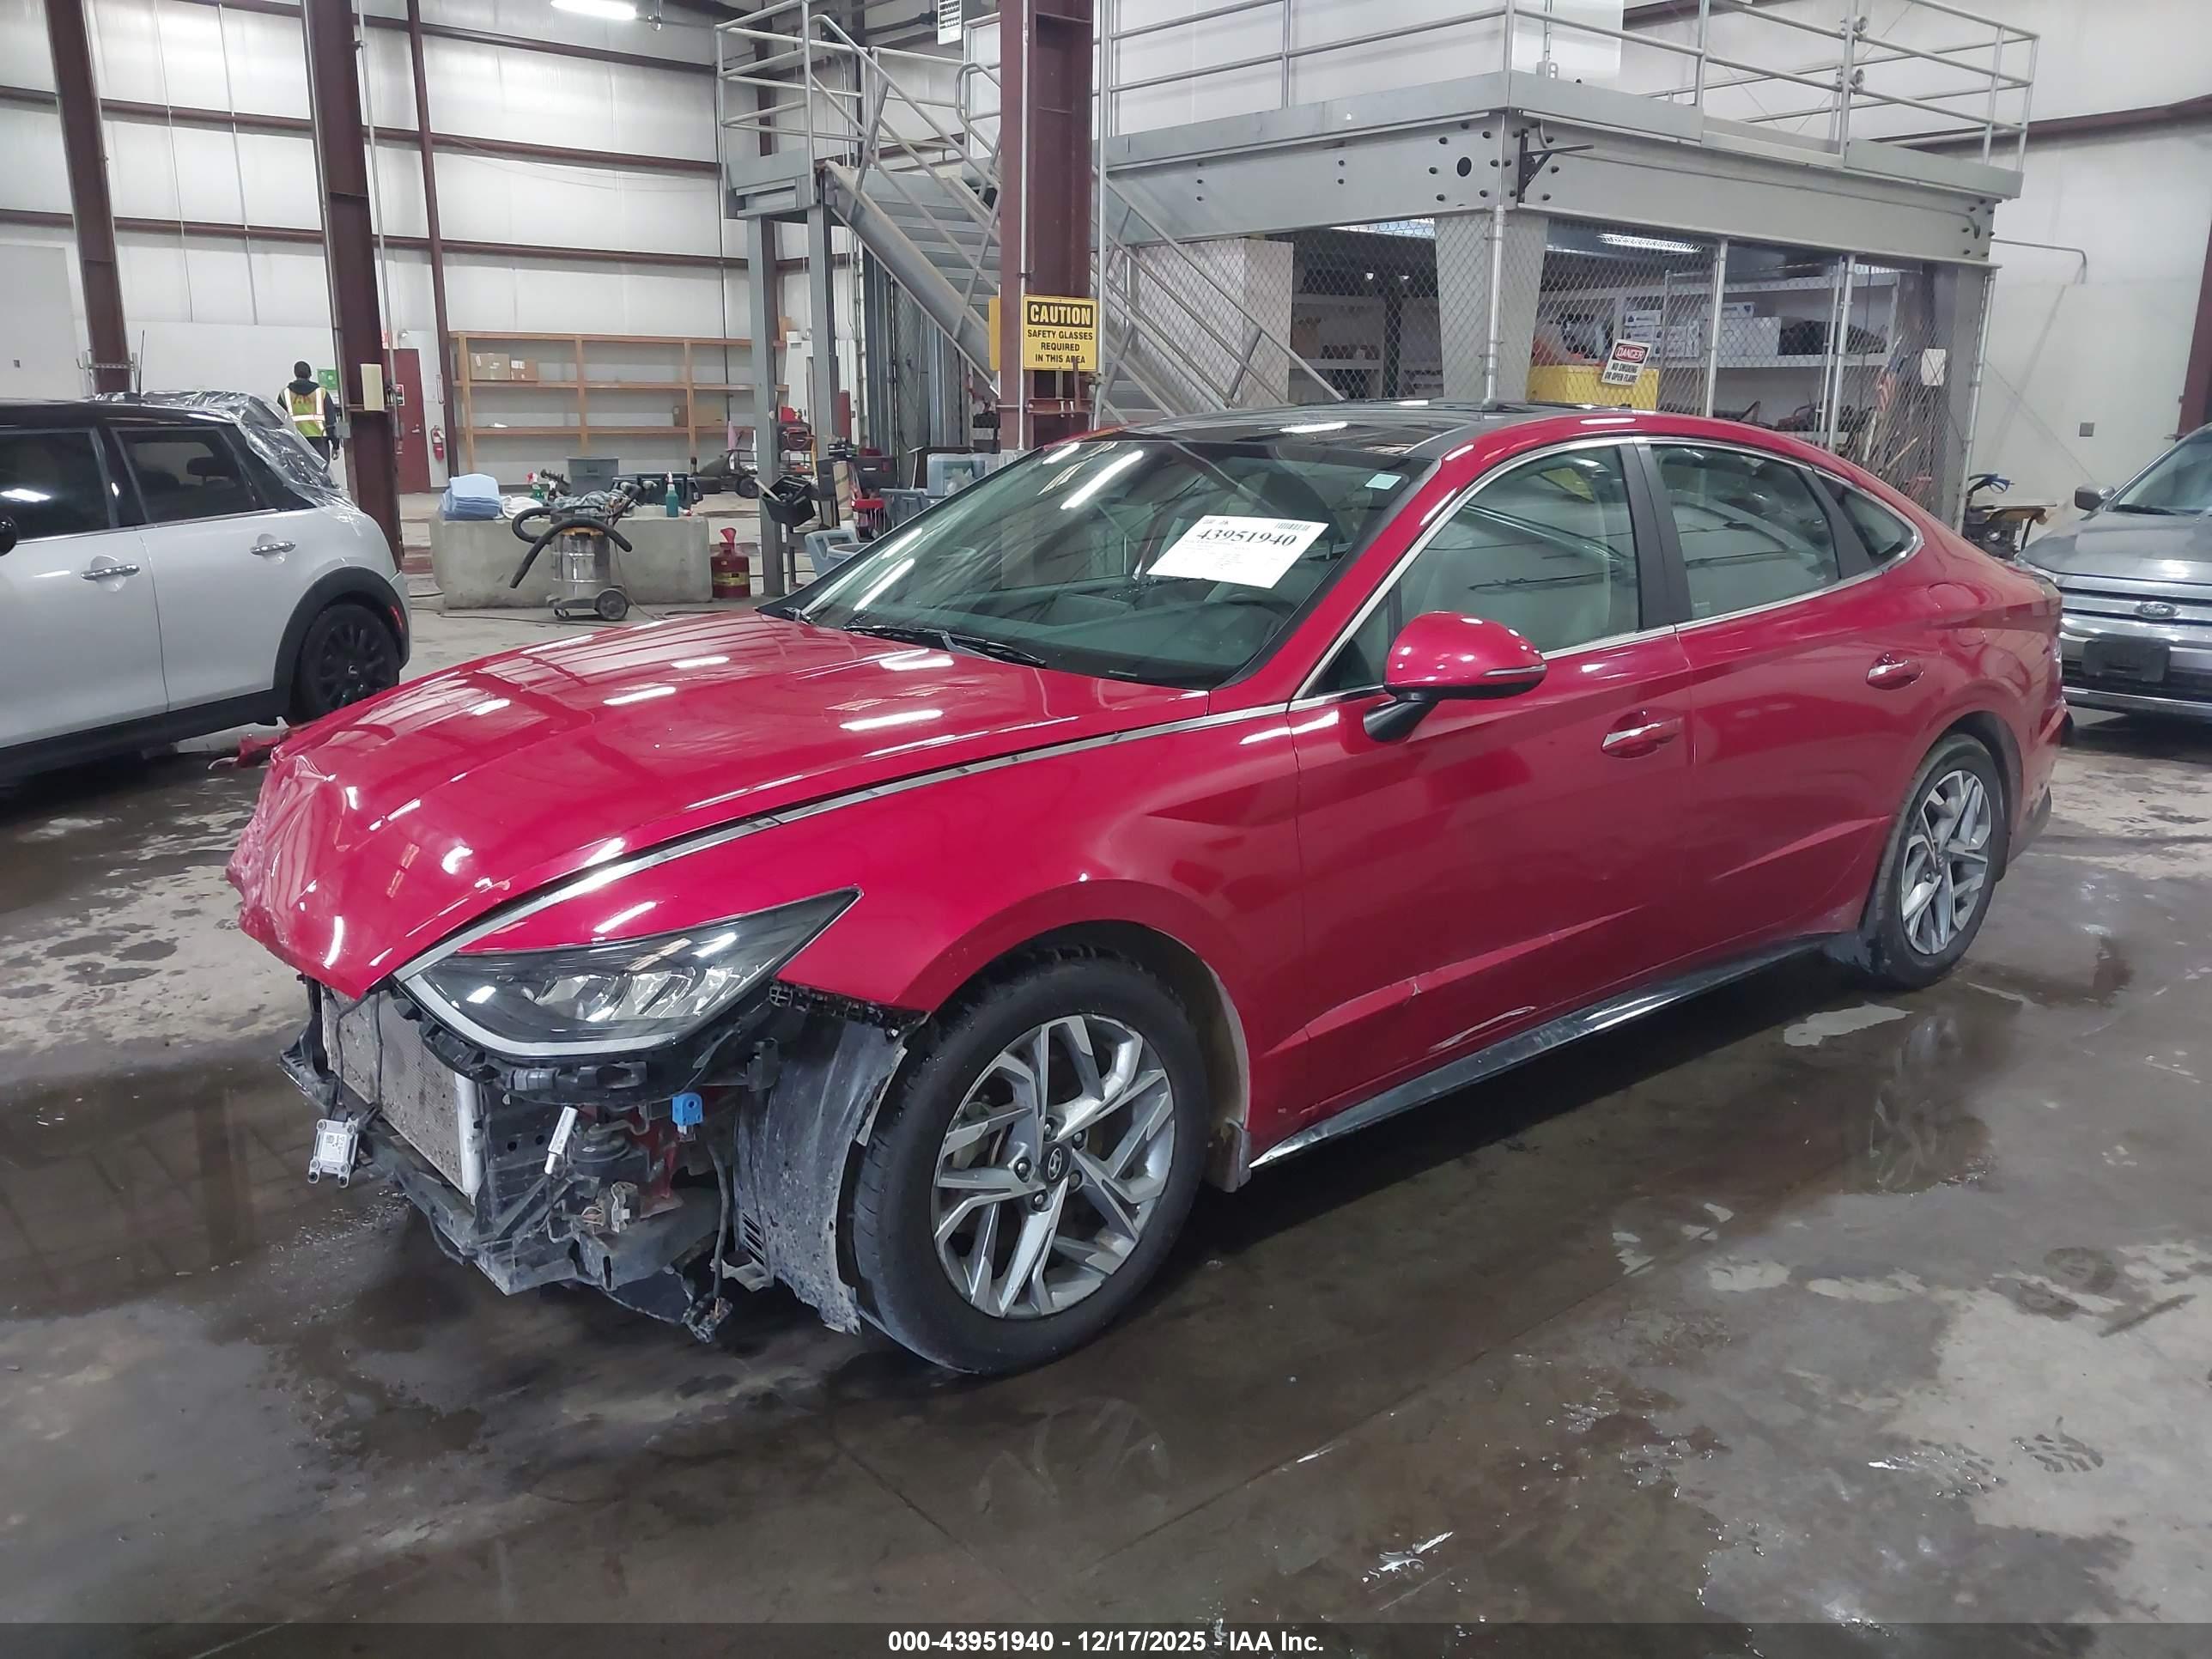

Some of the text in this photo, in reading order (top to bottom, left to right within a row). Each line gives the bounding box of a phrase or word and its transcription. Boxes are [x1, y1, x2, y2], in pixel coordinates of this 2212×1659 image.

[1030, 304, 1091, 325] CAUTION
[1028, 330, 1093, 340] SAFETY GLASSES
[1041, 342, 1080, 352] REQUIRED
[1035, 353, 1043, 362] IN
[1045, 354, 1064, 362] THIS
[1617, 347, 1644, 360] DANGER
[1611, 362, 1639, 374] NO SMOKING
[1604, 371, 1613, 380] OR
[1611, 372, 1624, 381] OPEN
[1196, 528, 1298, 546] 43951940
